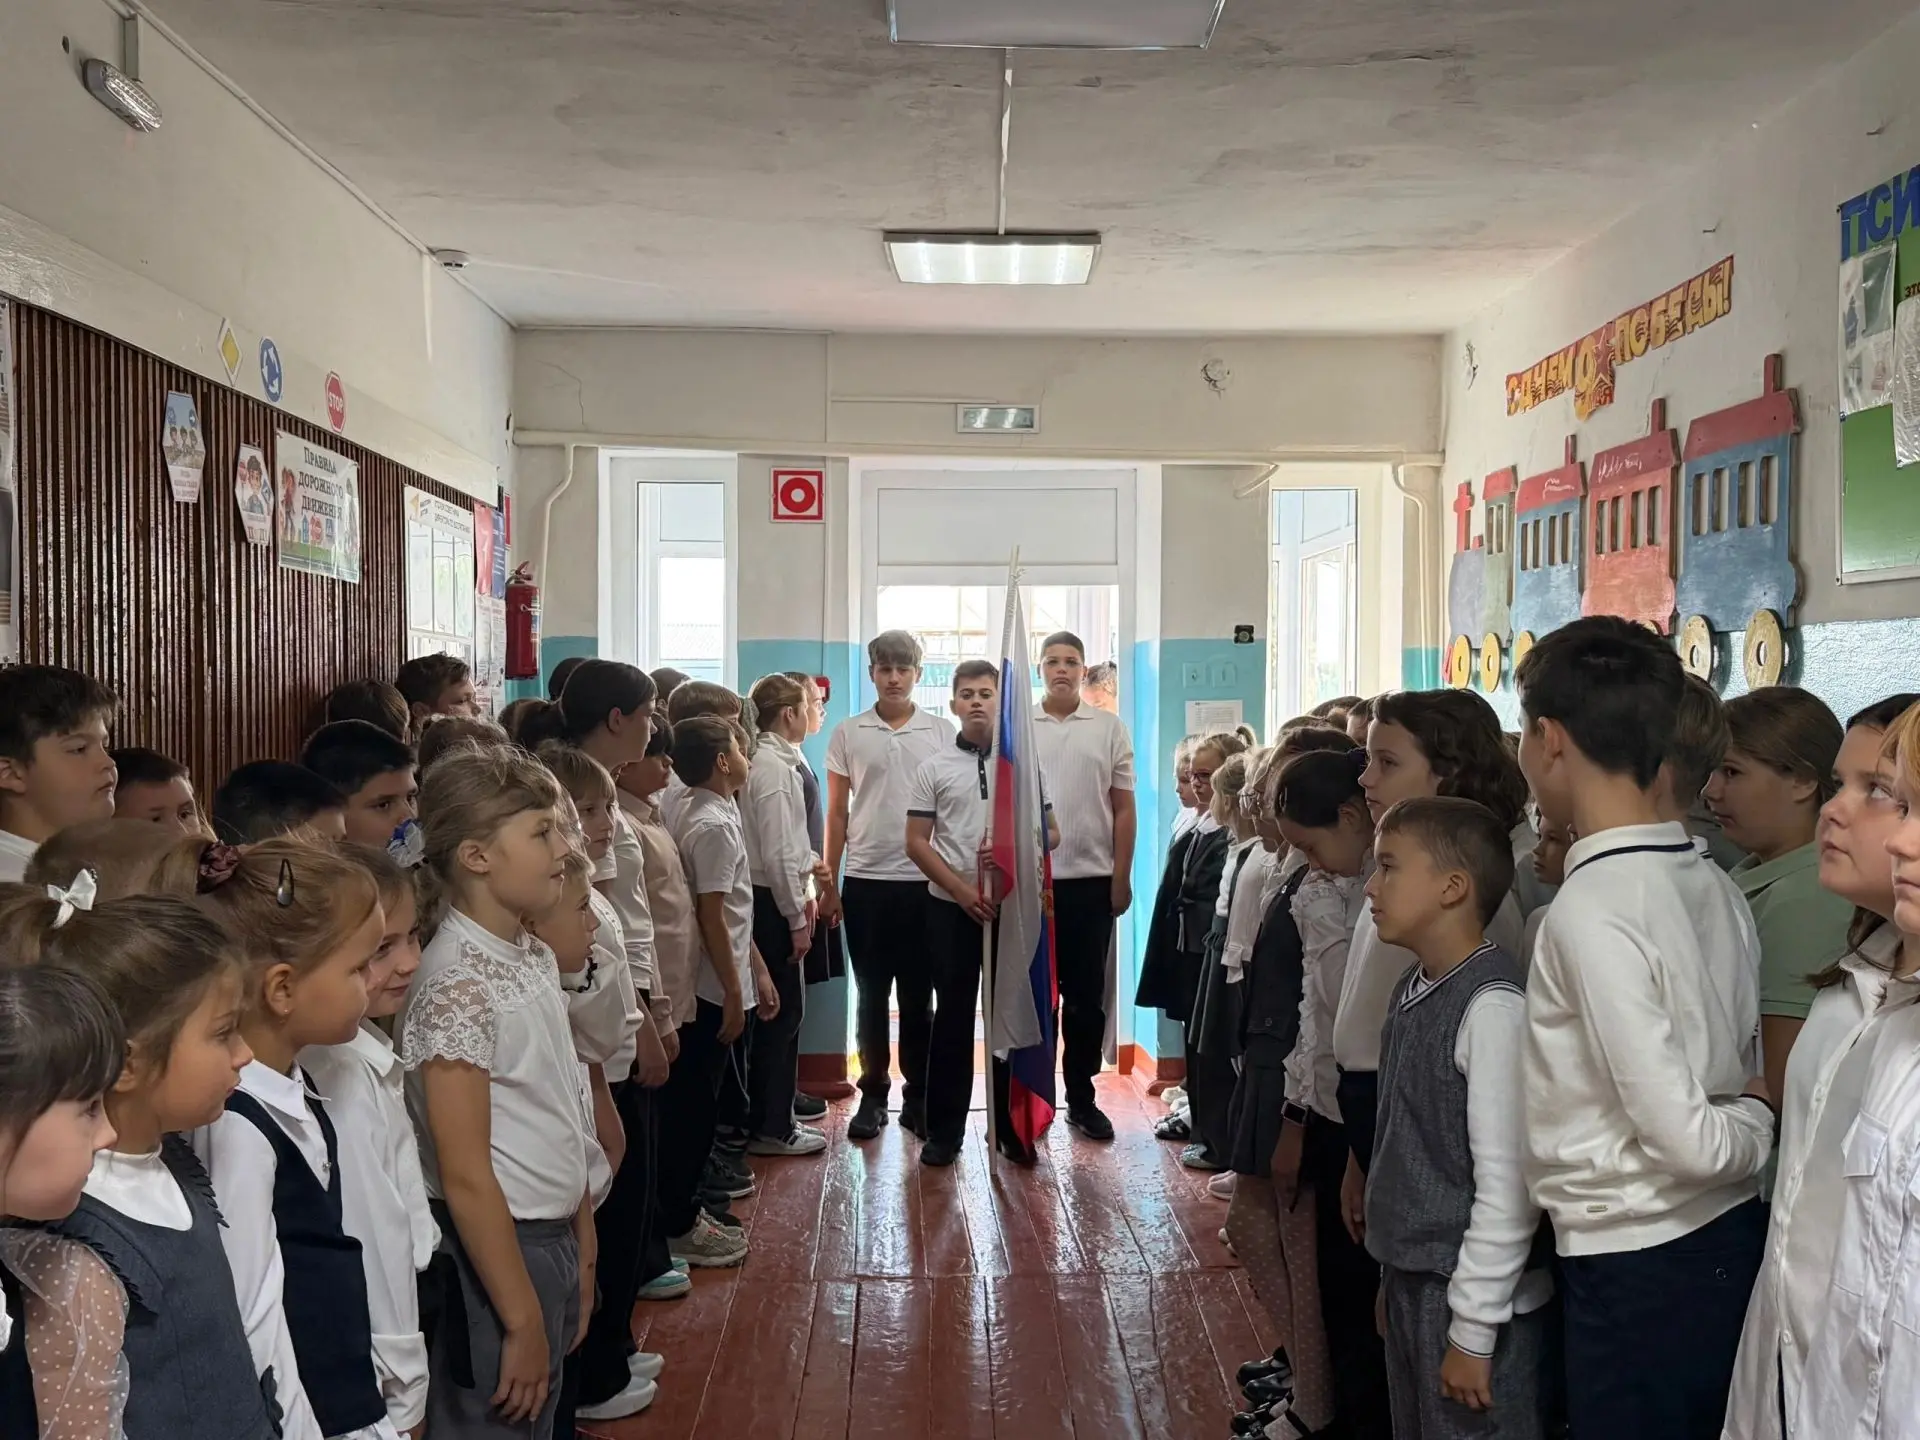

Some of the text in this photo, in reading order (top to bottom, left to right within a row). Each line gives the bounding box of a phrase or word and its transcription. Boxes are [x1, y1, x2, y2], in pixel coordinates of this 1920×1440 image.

[1841, 164, 1920, 262] ПСИ
[1614, 260, 1733, 366] ПОБЕДЫ!
[328, 391, 344, 414] STOP
